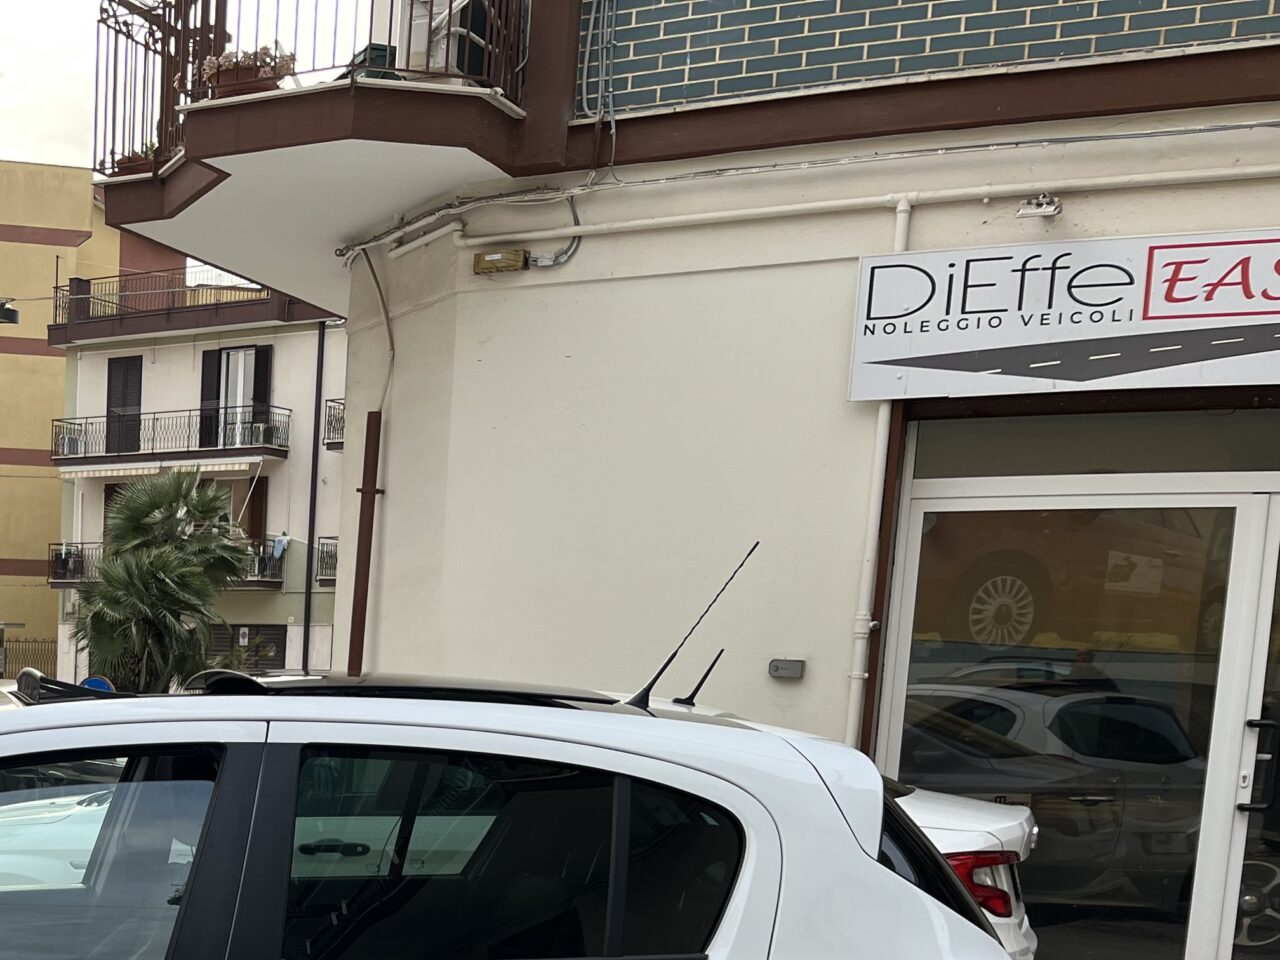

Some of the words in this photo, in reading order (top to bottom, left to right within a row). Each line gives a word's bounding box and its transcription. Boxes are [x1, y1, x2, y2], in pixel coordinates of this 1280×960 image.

[866, 252, 1135, 320] DiEffe
[863, 315, 1003, 336] NOLEGGIO
[1020, 308, 1134, 327] VEICOLI
